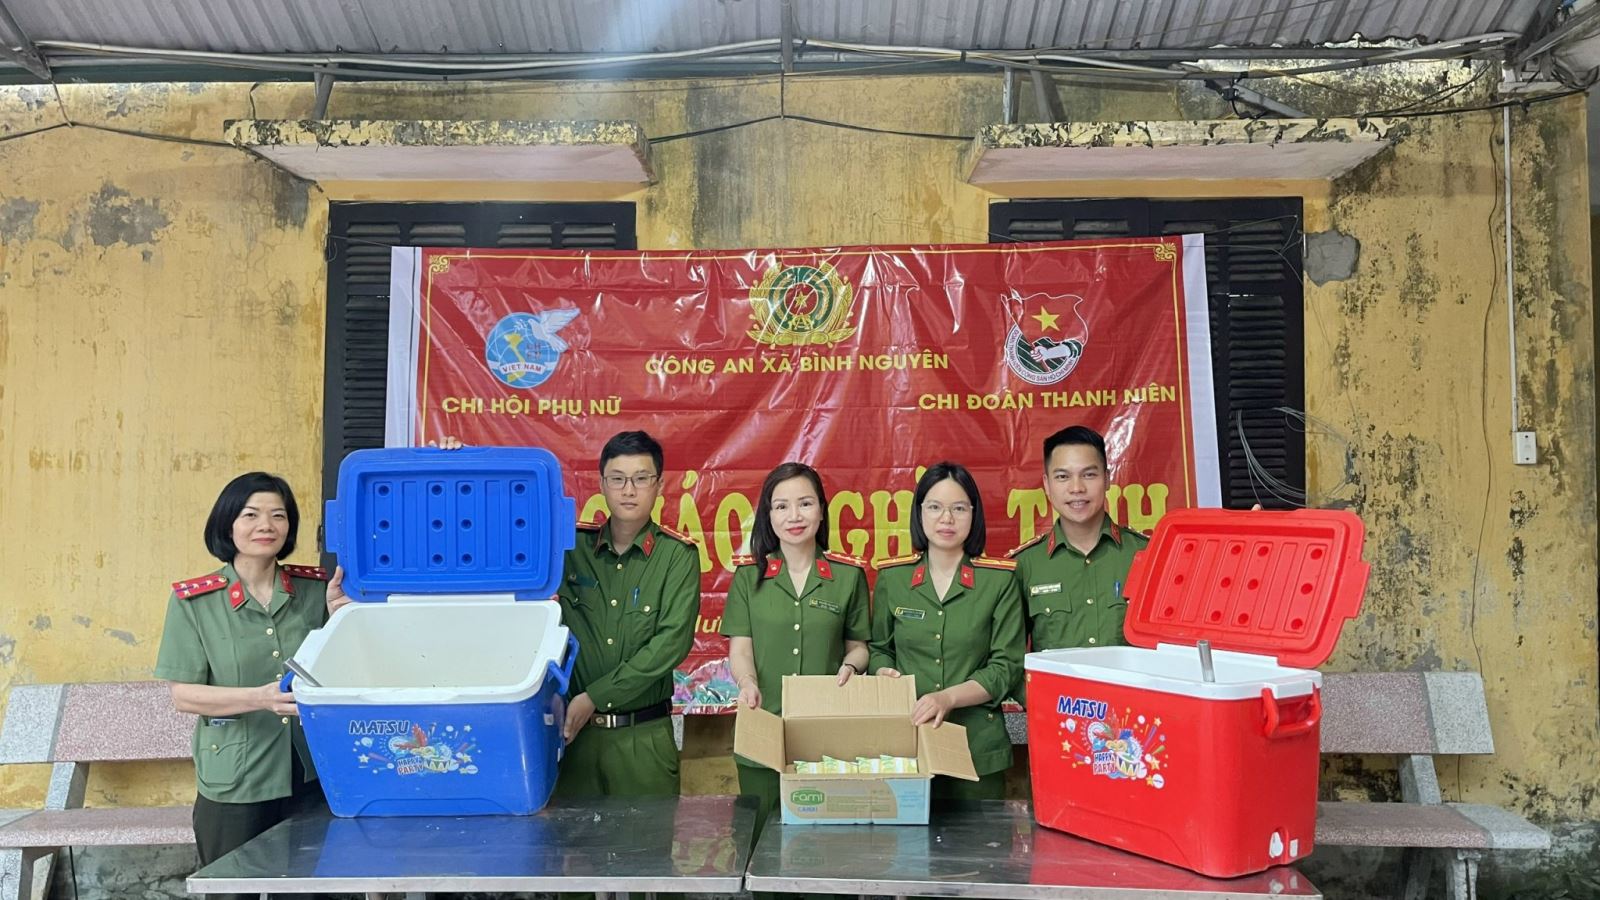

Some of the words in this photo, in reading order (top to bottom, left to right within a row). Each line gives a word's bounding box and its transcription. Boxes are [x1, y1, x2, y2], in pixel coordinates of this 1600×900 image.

[524, 364, 542, 372] NAM
[645, 355, 716, 375] CÔNG
[722, 358, 754, 374] AN
[762, 353, 793, 373] XÃ
[800, 351, 852, 372] BÌNH
[859, 348, 949, 370] NGUYÊN
[918, 393, 959, 410] CHI
[966, 390, 1033, 410] ĐOÀN
[1041, 389, 1117, 408] THANH
[1123, 382, 1176, 405] NIÊN
[441, 397, 483, 414] CHI
[491, 394, 530, 418] HỘI
[538, 399, 583, 418] PHỤ
[590, 395, 622, 415] NỮ
[1057, 695, 1108, 720] MATSU
[349, 720, 410, 735] MATSU
[397, 763, 424, 776] PARTY
[793, 791, 823, 802] Fami
